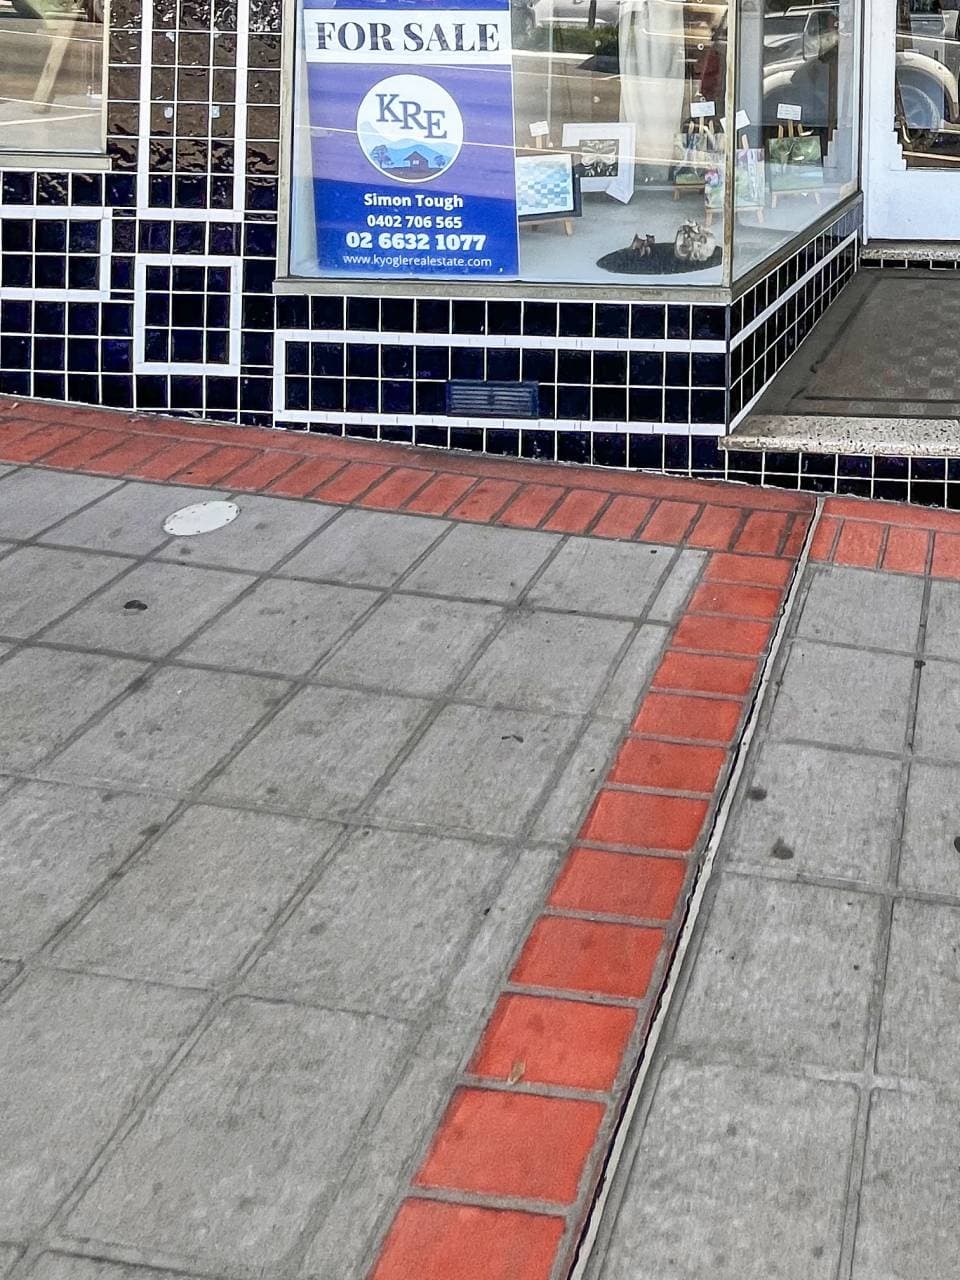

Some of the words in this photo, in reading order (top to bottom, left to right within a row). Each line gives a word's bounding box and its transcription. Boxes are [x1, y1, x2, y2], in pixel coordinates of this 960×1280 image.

[315, 21, 395, 51] FOR
[403, 22, 500, 52] SALE
[375, 93, 448, 139] KRE
[364, 193, 412, 207] Simon
[415, 194, 464, 211] Tough
[367, 214, 402, 228] 0402
[405, 215, 433, 228] 706
[436, 216, 463, 229] 565
[346, 231, 373, 249] 02
[378, 232, 430, 250] 6632
[436, 234, 487, 251] 1077
[343, 254, 493, 268] www.kyoglerealestate.com
